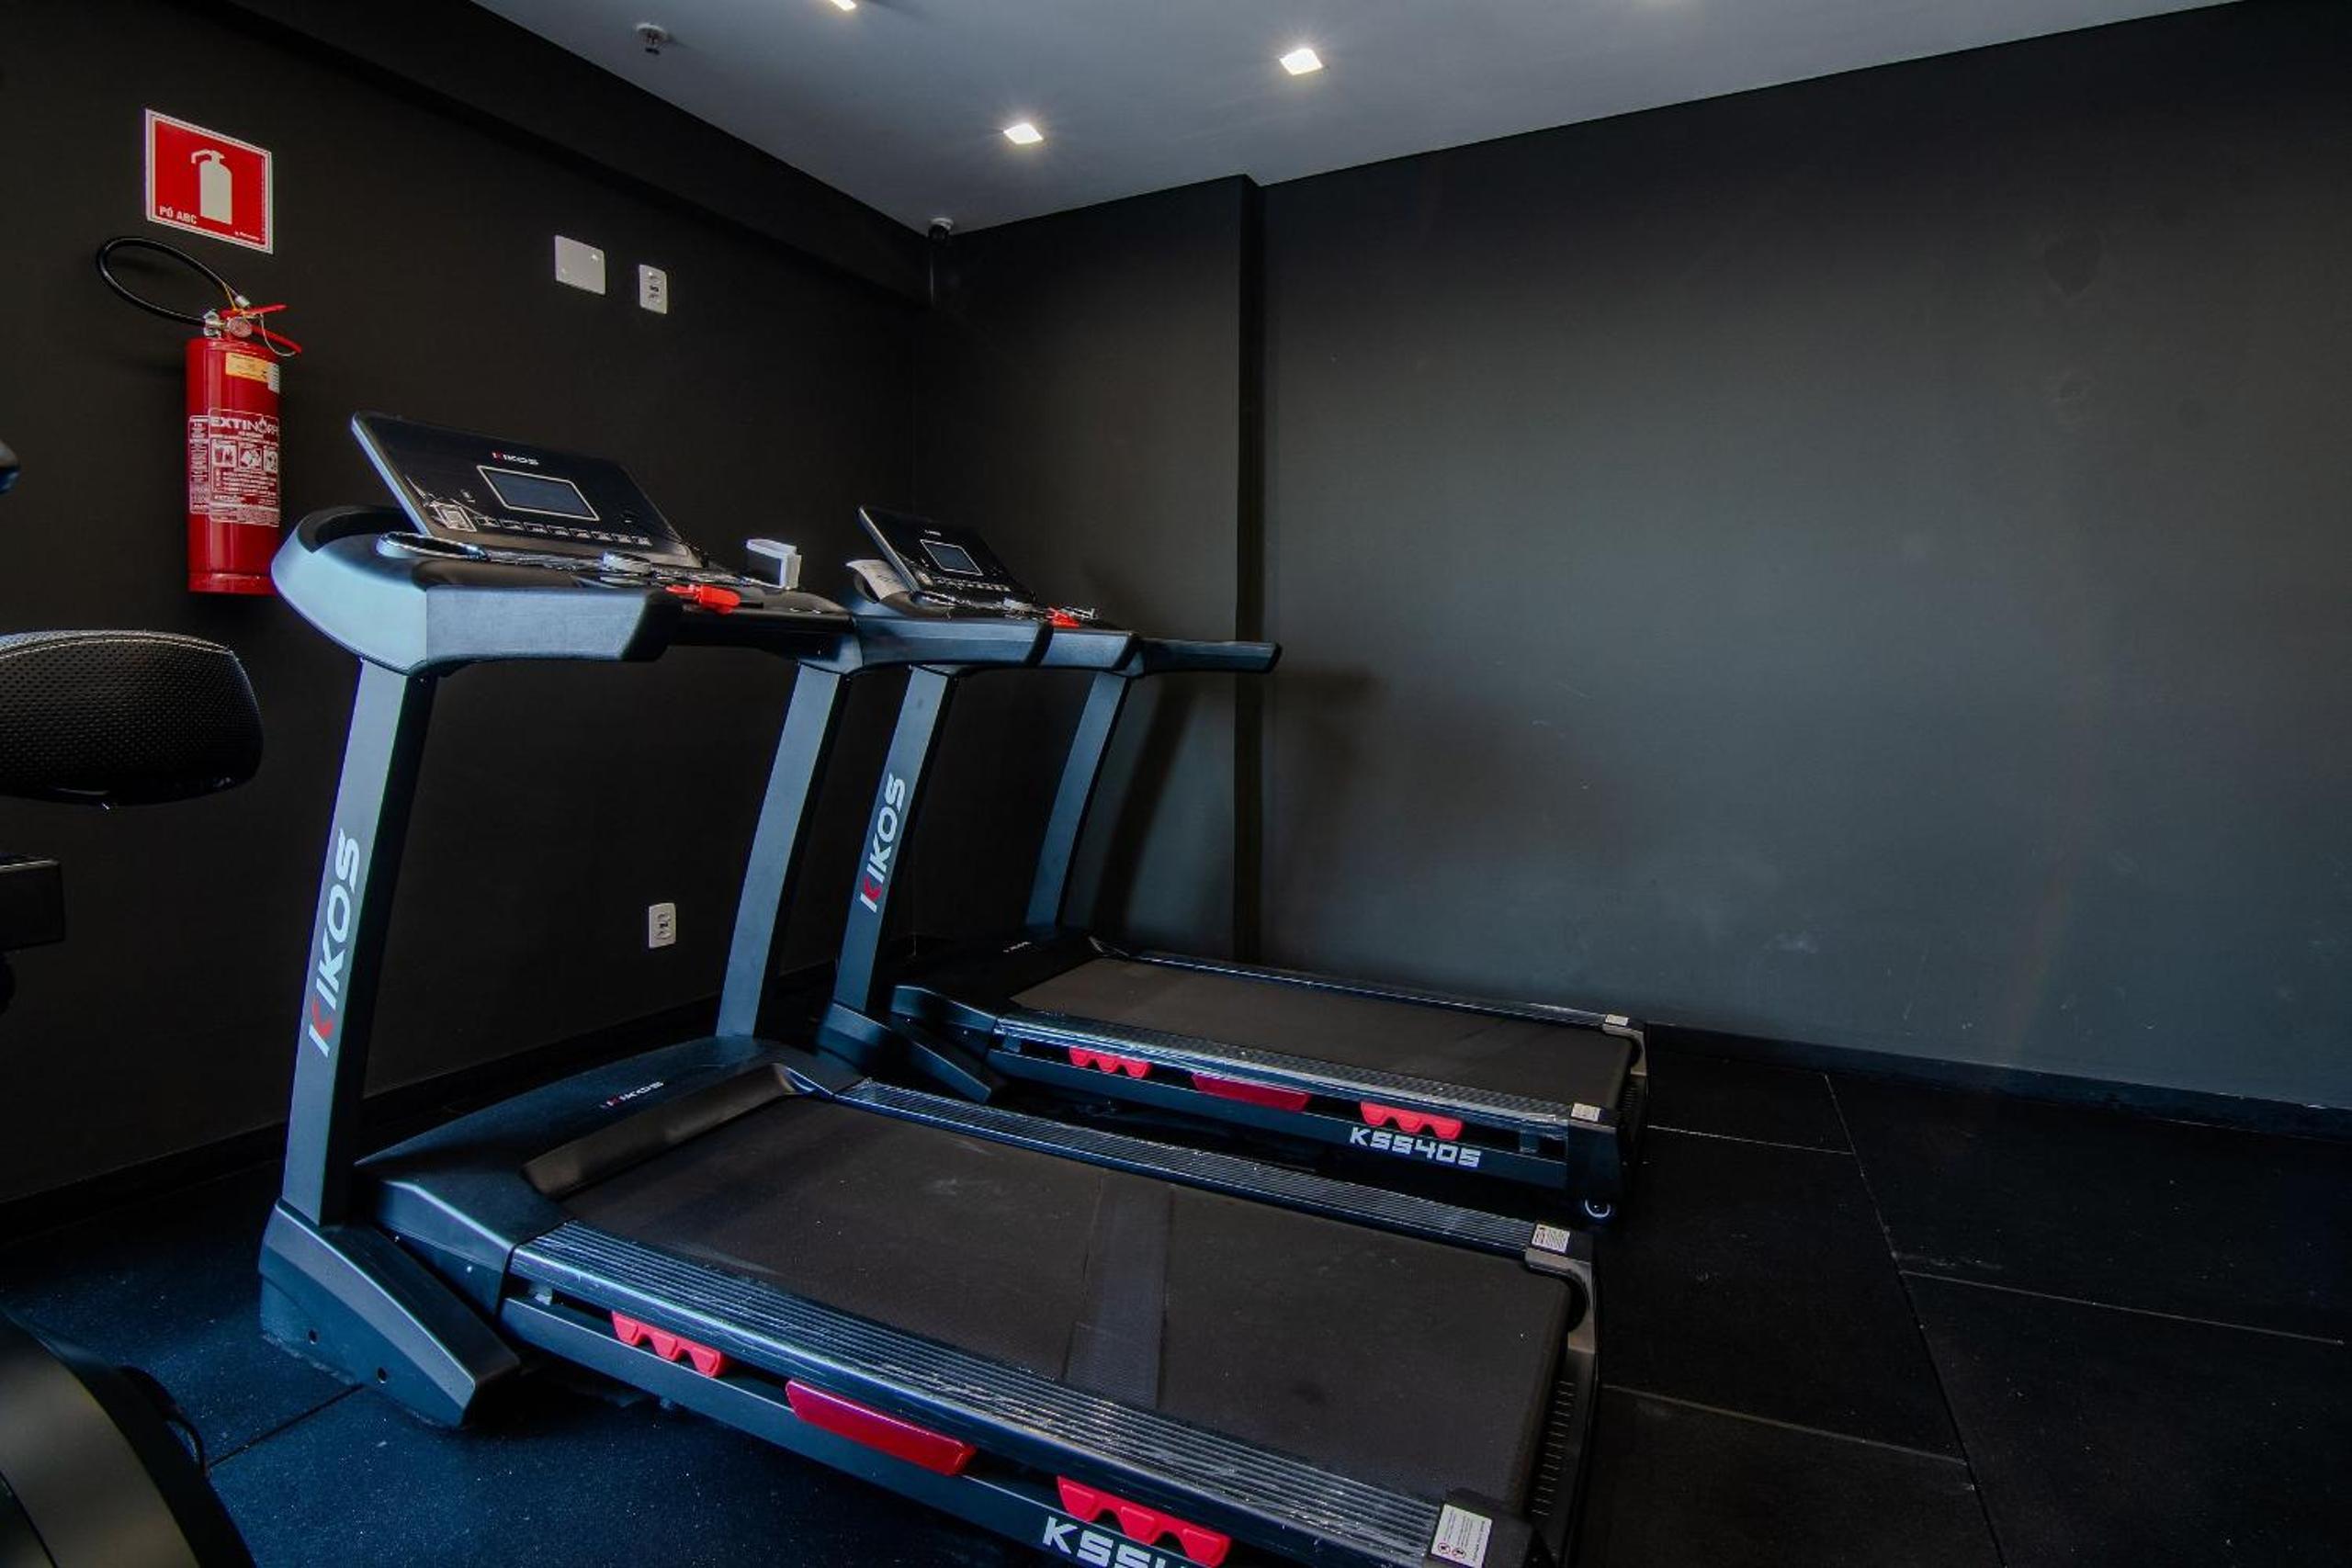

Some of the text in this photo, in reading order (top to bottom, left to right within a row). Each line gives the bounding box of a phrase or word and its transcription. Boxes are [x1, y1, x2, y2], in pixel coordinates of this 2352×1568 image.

[176, 211, 198, 225] ABC
[860, 772, 906, 913] KIKOS
[309, 828, 360, 1059] KIKOS
